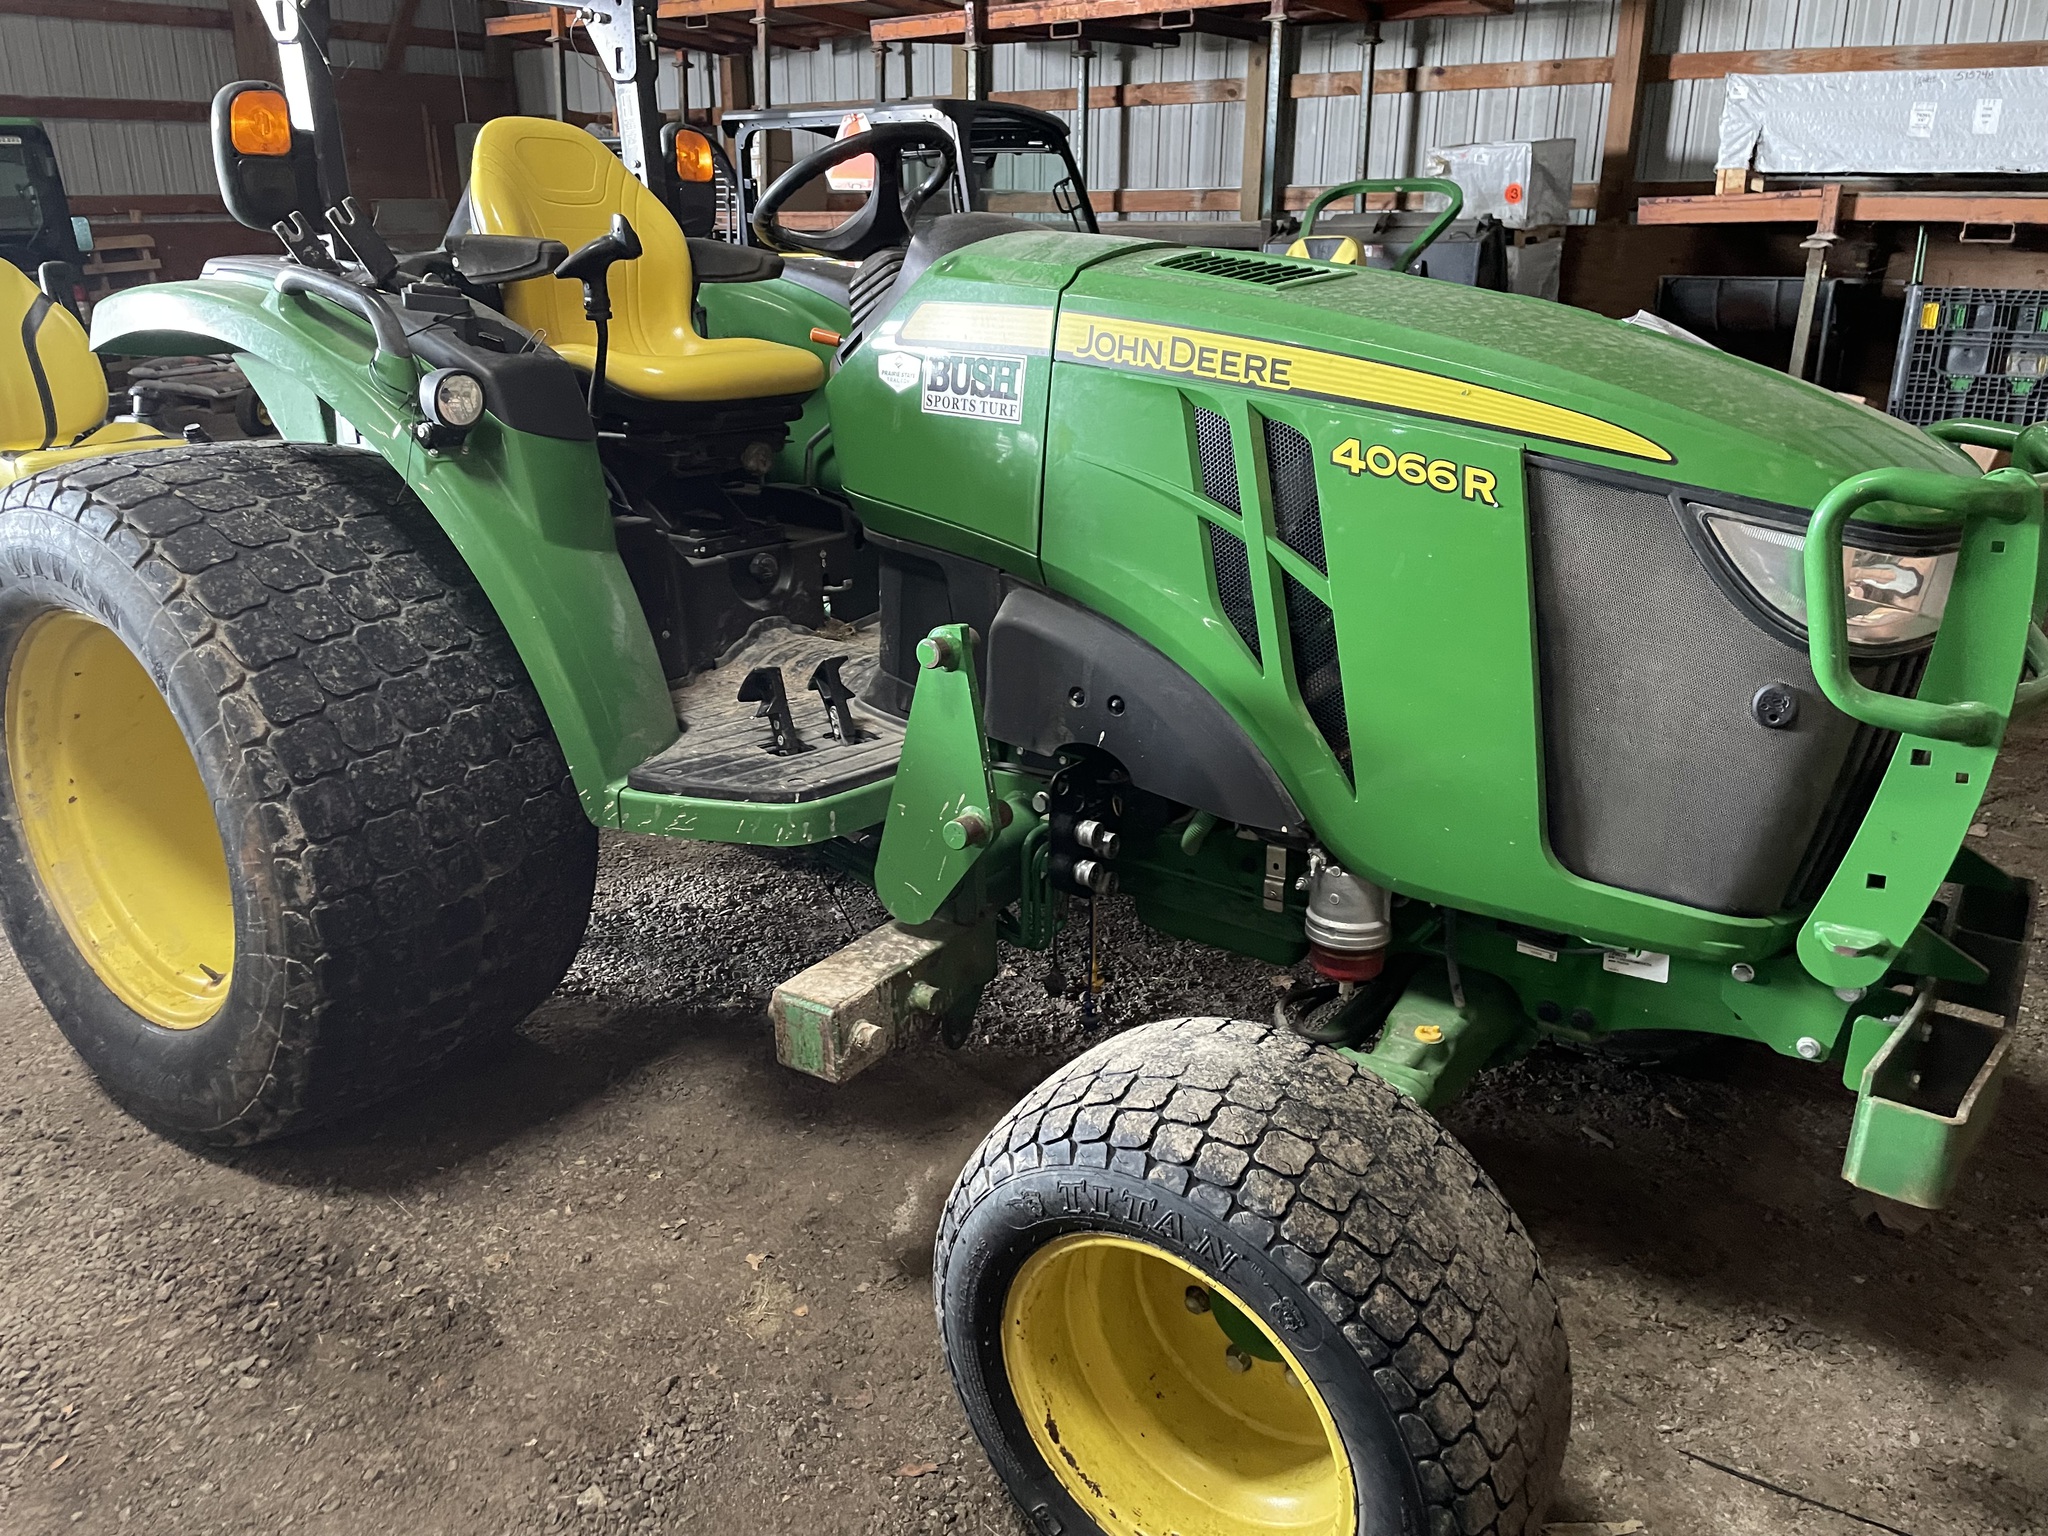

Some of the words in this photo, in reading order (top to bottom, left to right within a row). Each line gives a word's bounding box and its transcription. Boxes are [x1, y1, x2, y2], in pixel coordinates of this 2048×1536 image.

[1510, 187, 1519, 199] 3
[927, 355, 1021, 401] BUSH
[1076, 324, 1163, 365] JOHN
[1169, 336, 1292, 386] DEERE
[926, 394, 976, 413] SPORTS
[980, 400, 1018, 418] TURF
[1330, 436, 1498, 507] 4066R
[1057, 1178, 1244, 1274] TITAN
